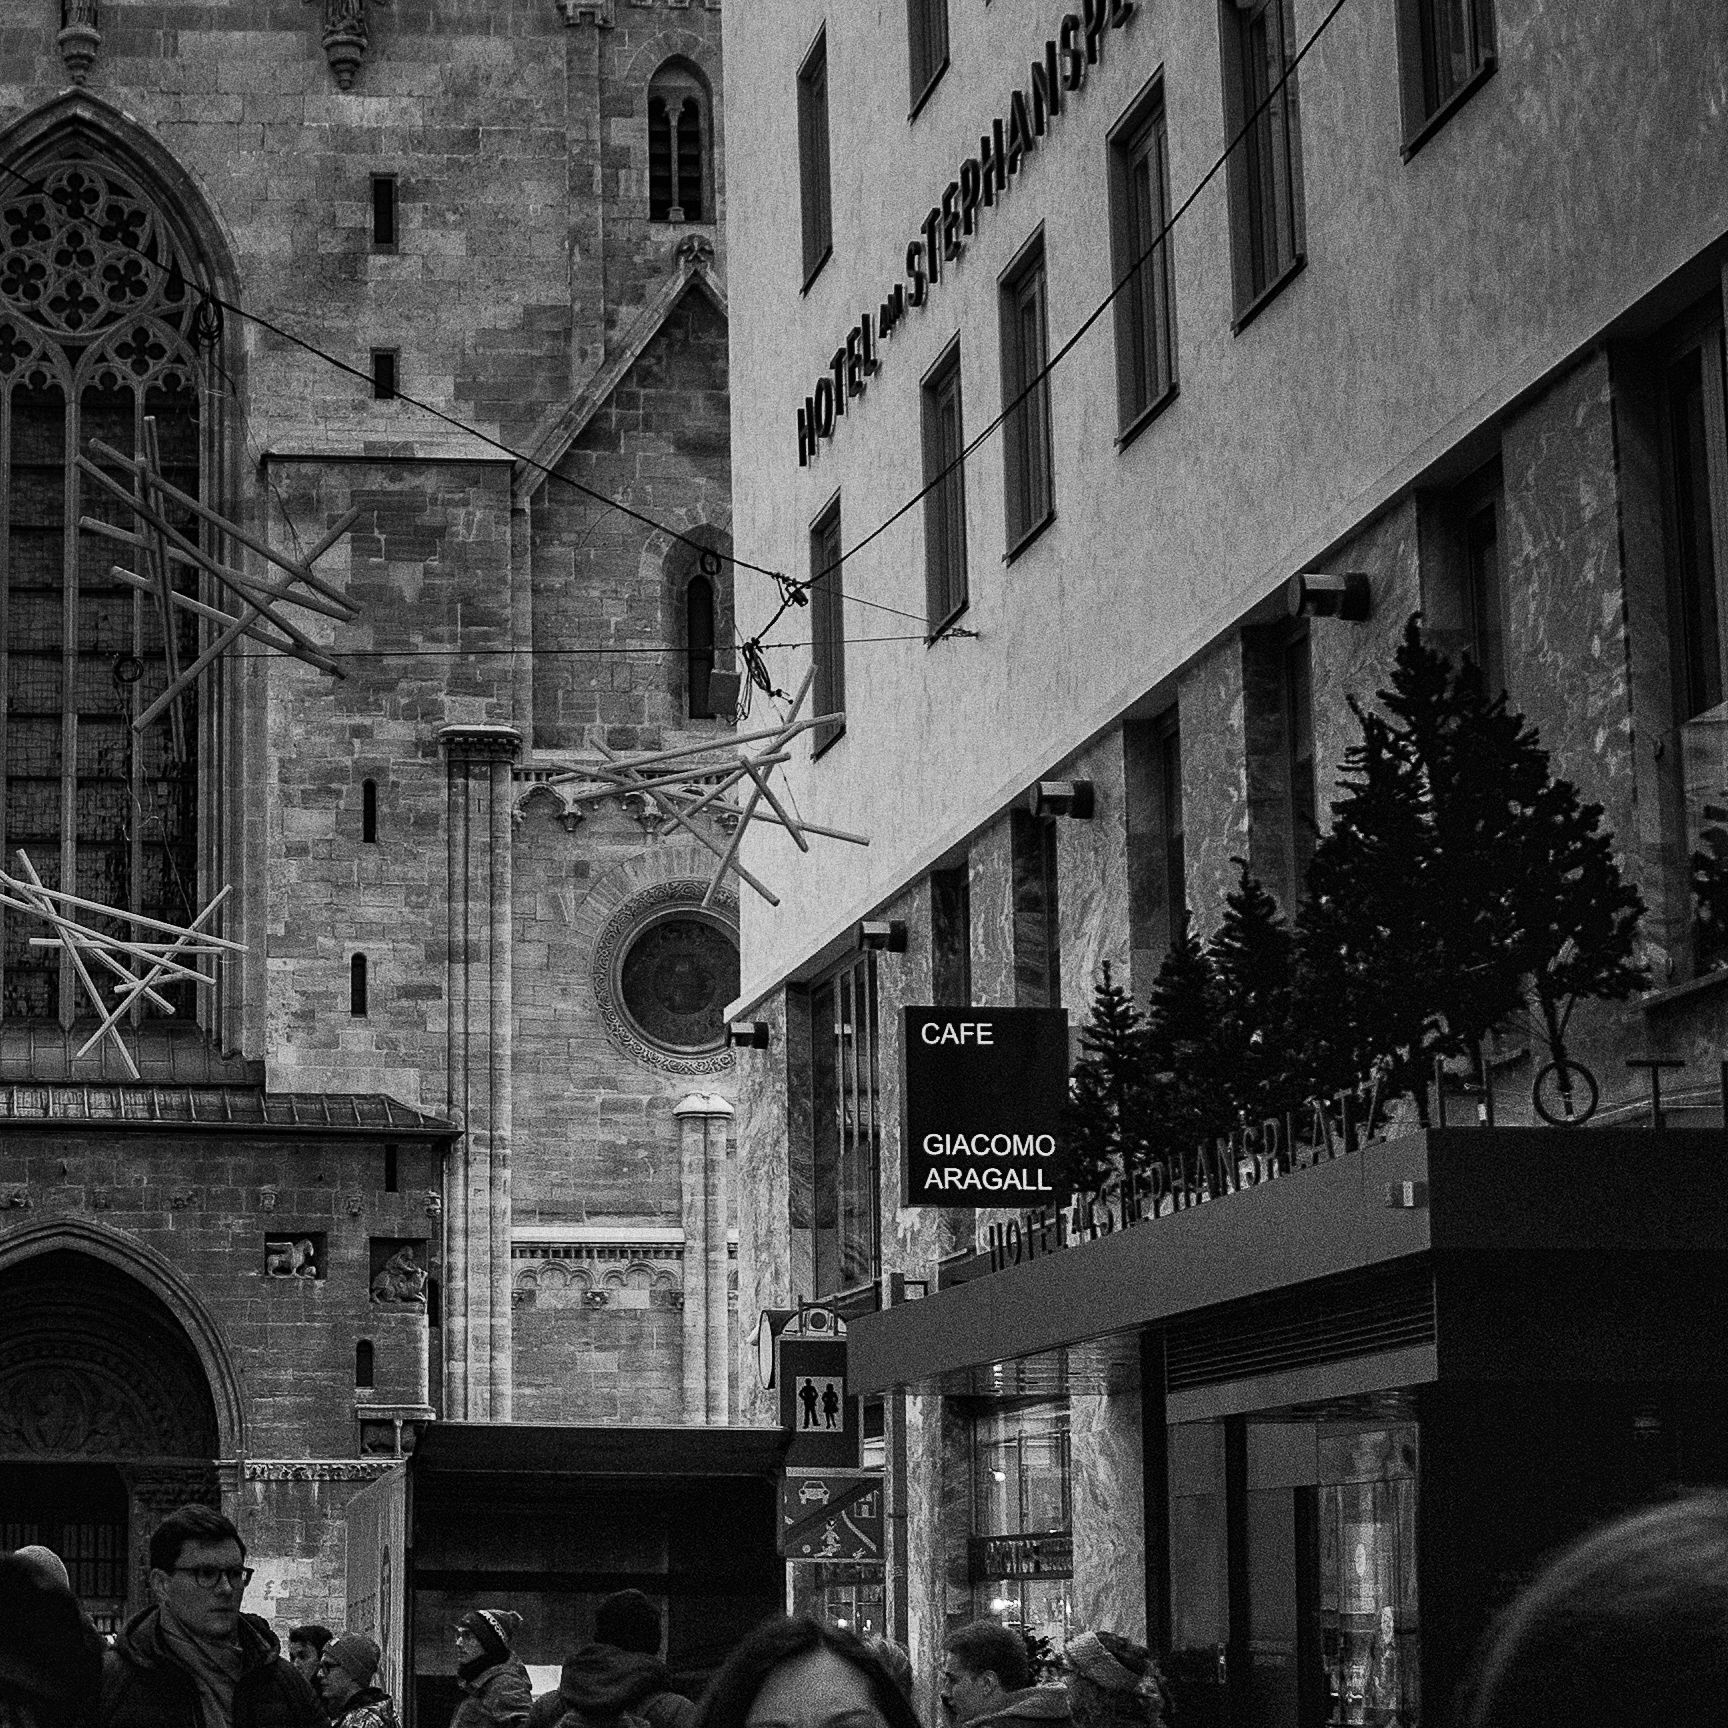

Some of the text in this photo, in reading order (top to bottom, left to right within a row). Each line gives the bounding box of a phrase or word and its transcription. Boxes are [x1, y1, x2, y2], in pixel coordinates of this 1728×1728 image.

[797, 313, 881, 466] HOTEL
[921, 1022, 995, 1045] CAFE
[922, 1133, 1056, 1157] GIACOMO
[923, 1167, 1053, 1191] ARAGALL
